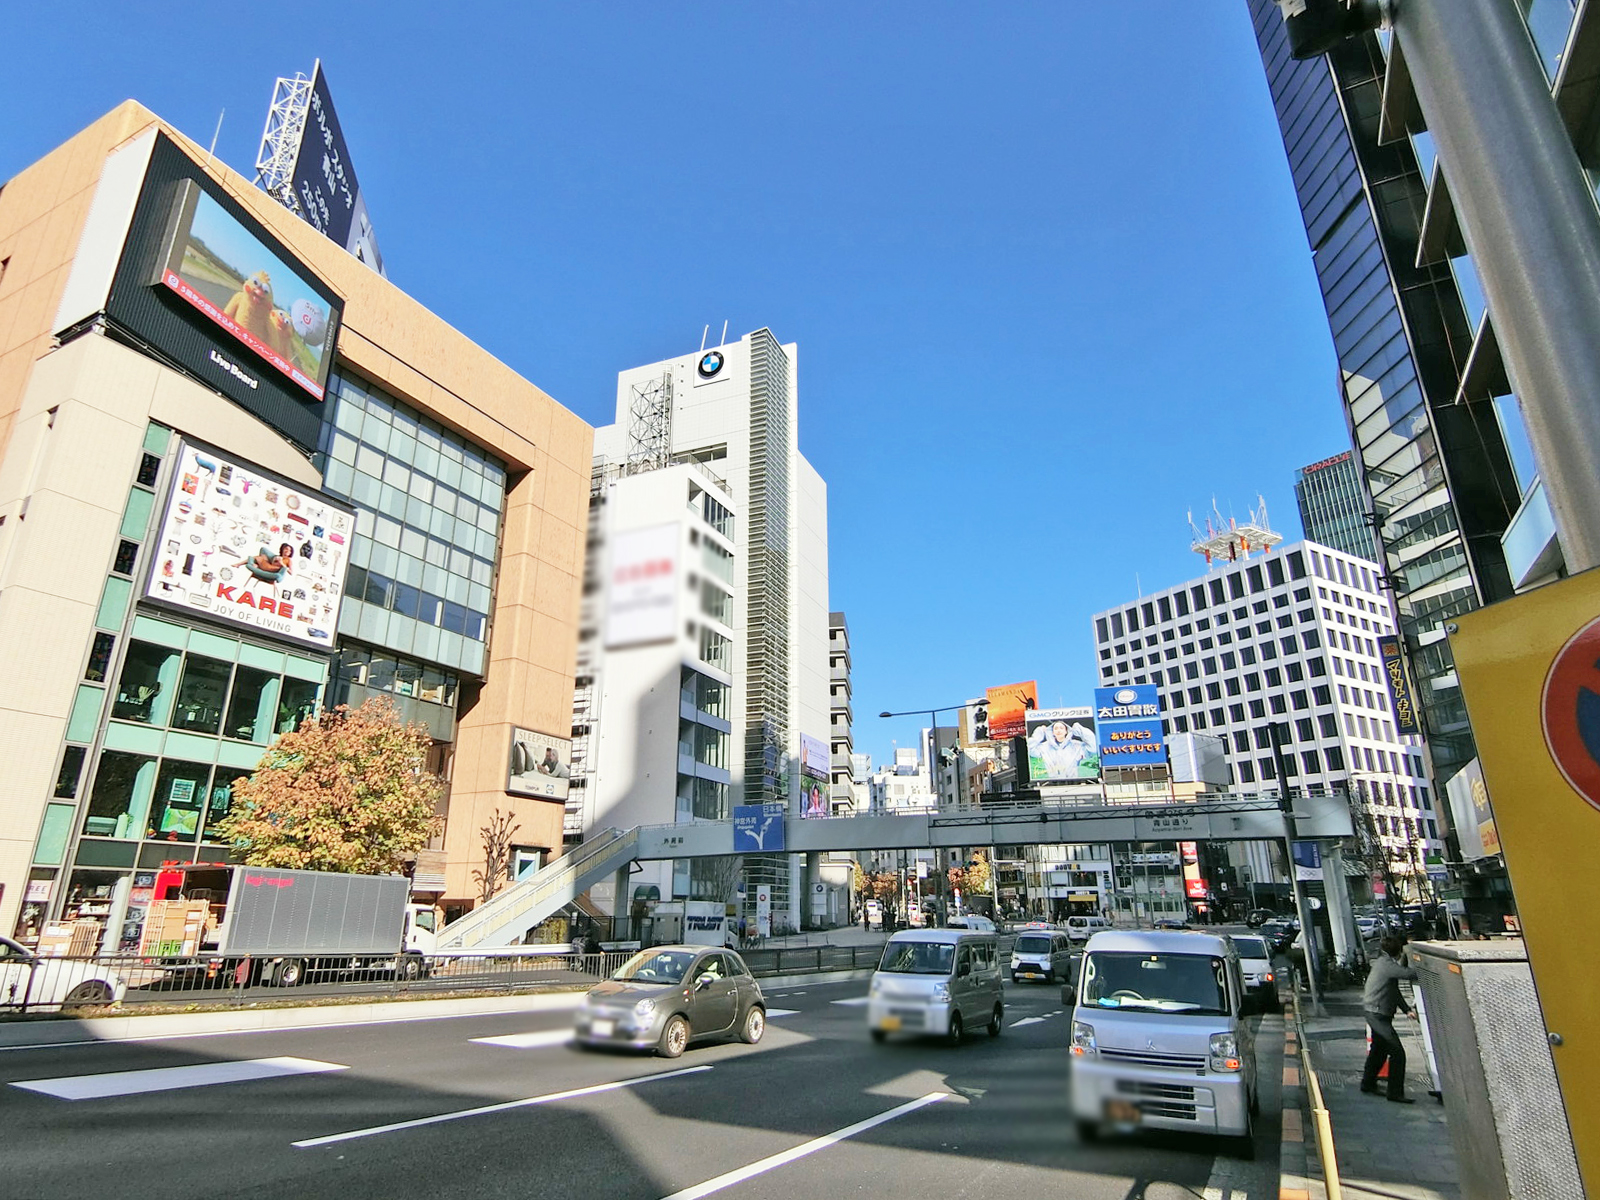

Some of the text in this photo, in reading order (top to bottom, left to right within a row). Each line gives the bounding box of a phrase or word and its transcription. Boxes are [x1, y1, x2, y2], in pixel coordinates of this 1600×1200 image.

[1304, 452, 1351, 474] ORACLE
[216, 583, 295, 619] KARE
[213, 604, 292, 633] JOY OF LIVING
[1097, 704, 1158, 718] 太田胃散
[518, 730, 568, 750] SLEEP SELECT
[1110, 729, 1152, 741] ありがとう
[1103, 743, 1161, 755] いいくすりです
[1153, 818, 1189, 827] 青山通り
